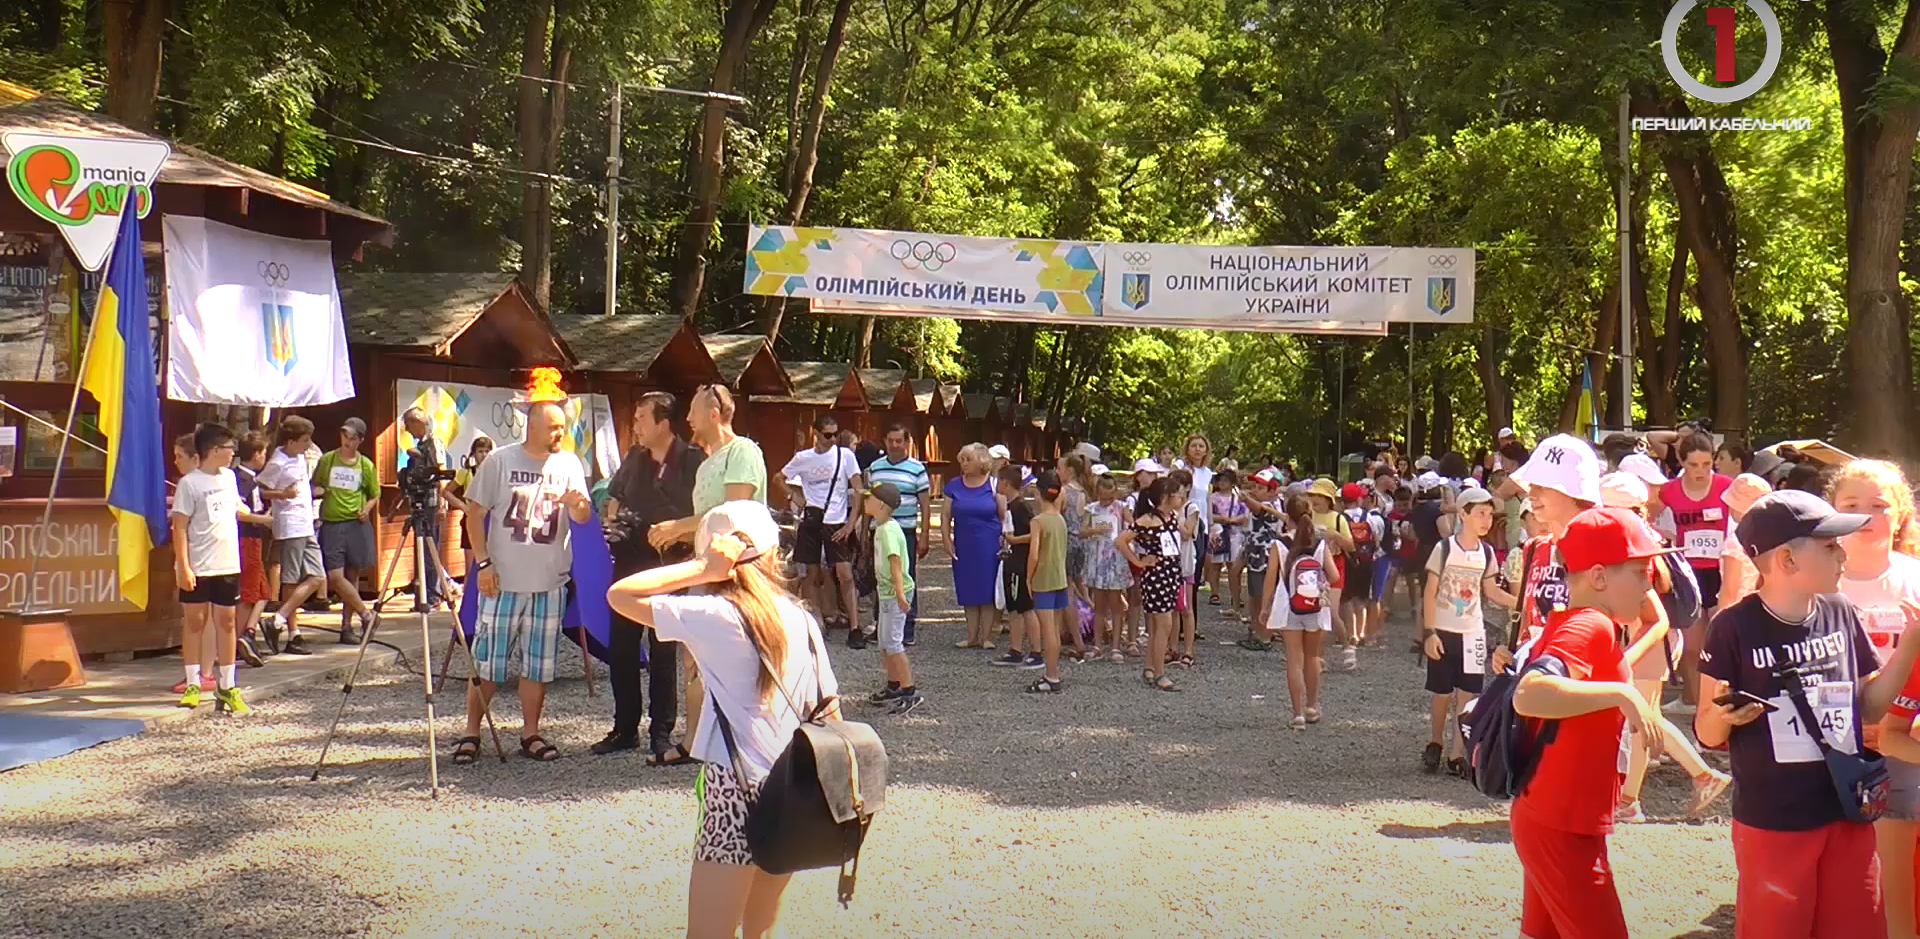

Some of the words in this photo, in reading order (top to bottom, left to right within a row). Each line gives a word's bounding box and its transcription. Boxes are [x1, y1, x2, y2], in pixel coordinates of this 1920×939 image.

[83, 166, 146, 182] mania
[1210, 253, 1369, 273] НАЦІОНАЛЬНИЙ
[815, 276, 967, 301] ОЛІМПІЙСЬКИЙ
[970, 286, 1026, 305] ДЕНЬ
[1165, 272, 1318, 293] ОЛІМПІЙСЬКИЙ
[1327, 277, 1413, 293] КОМІТЕТ
[1245, 295, 1330, 314] УКРАЇНИ
[1691, 537, 1718, 548] 1953
[1531, 563, 1561, 582] GIRL
[1525, 583, 1569, 603] OWER!
[1786, 709, 1845, 737] 145
